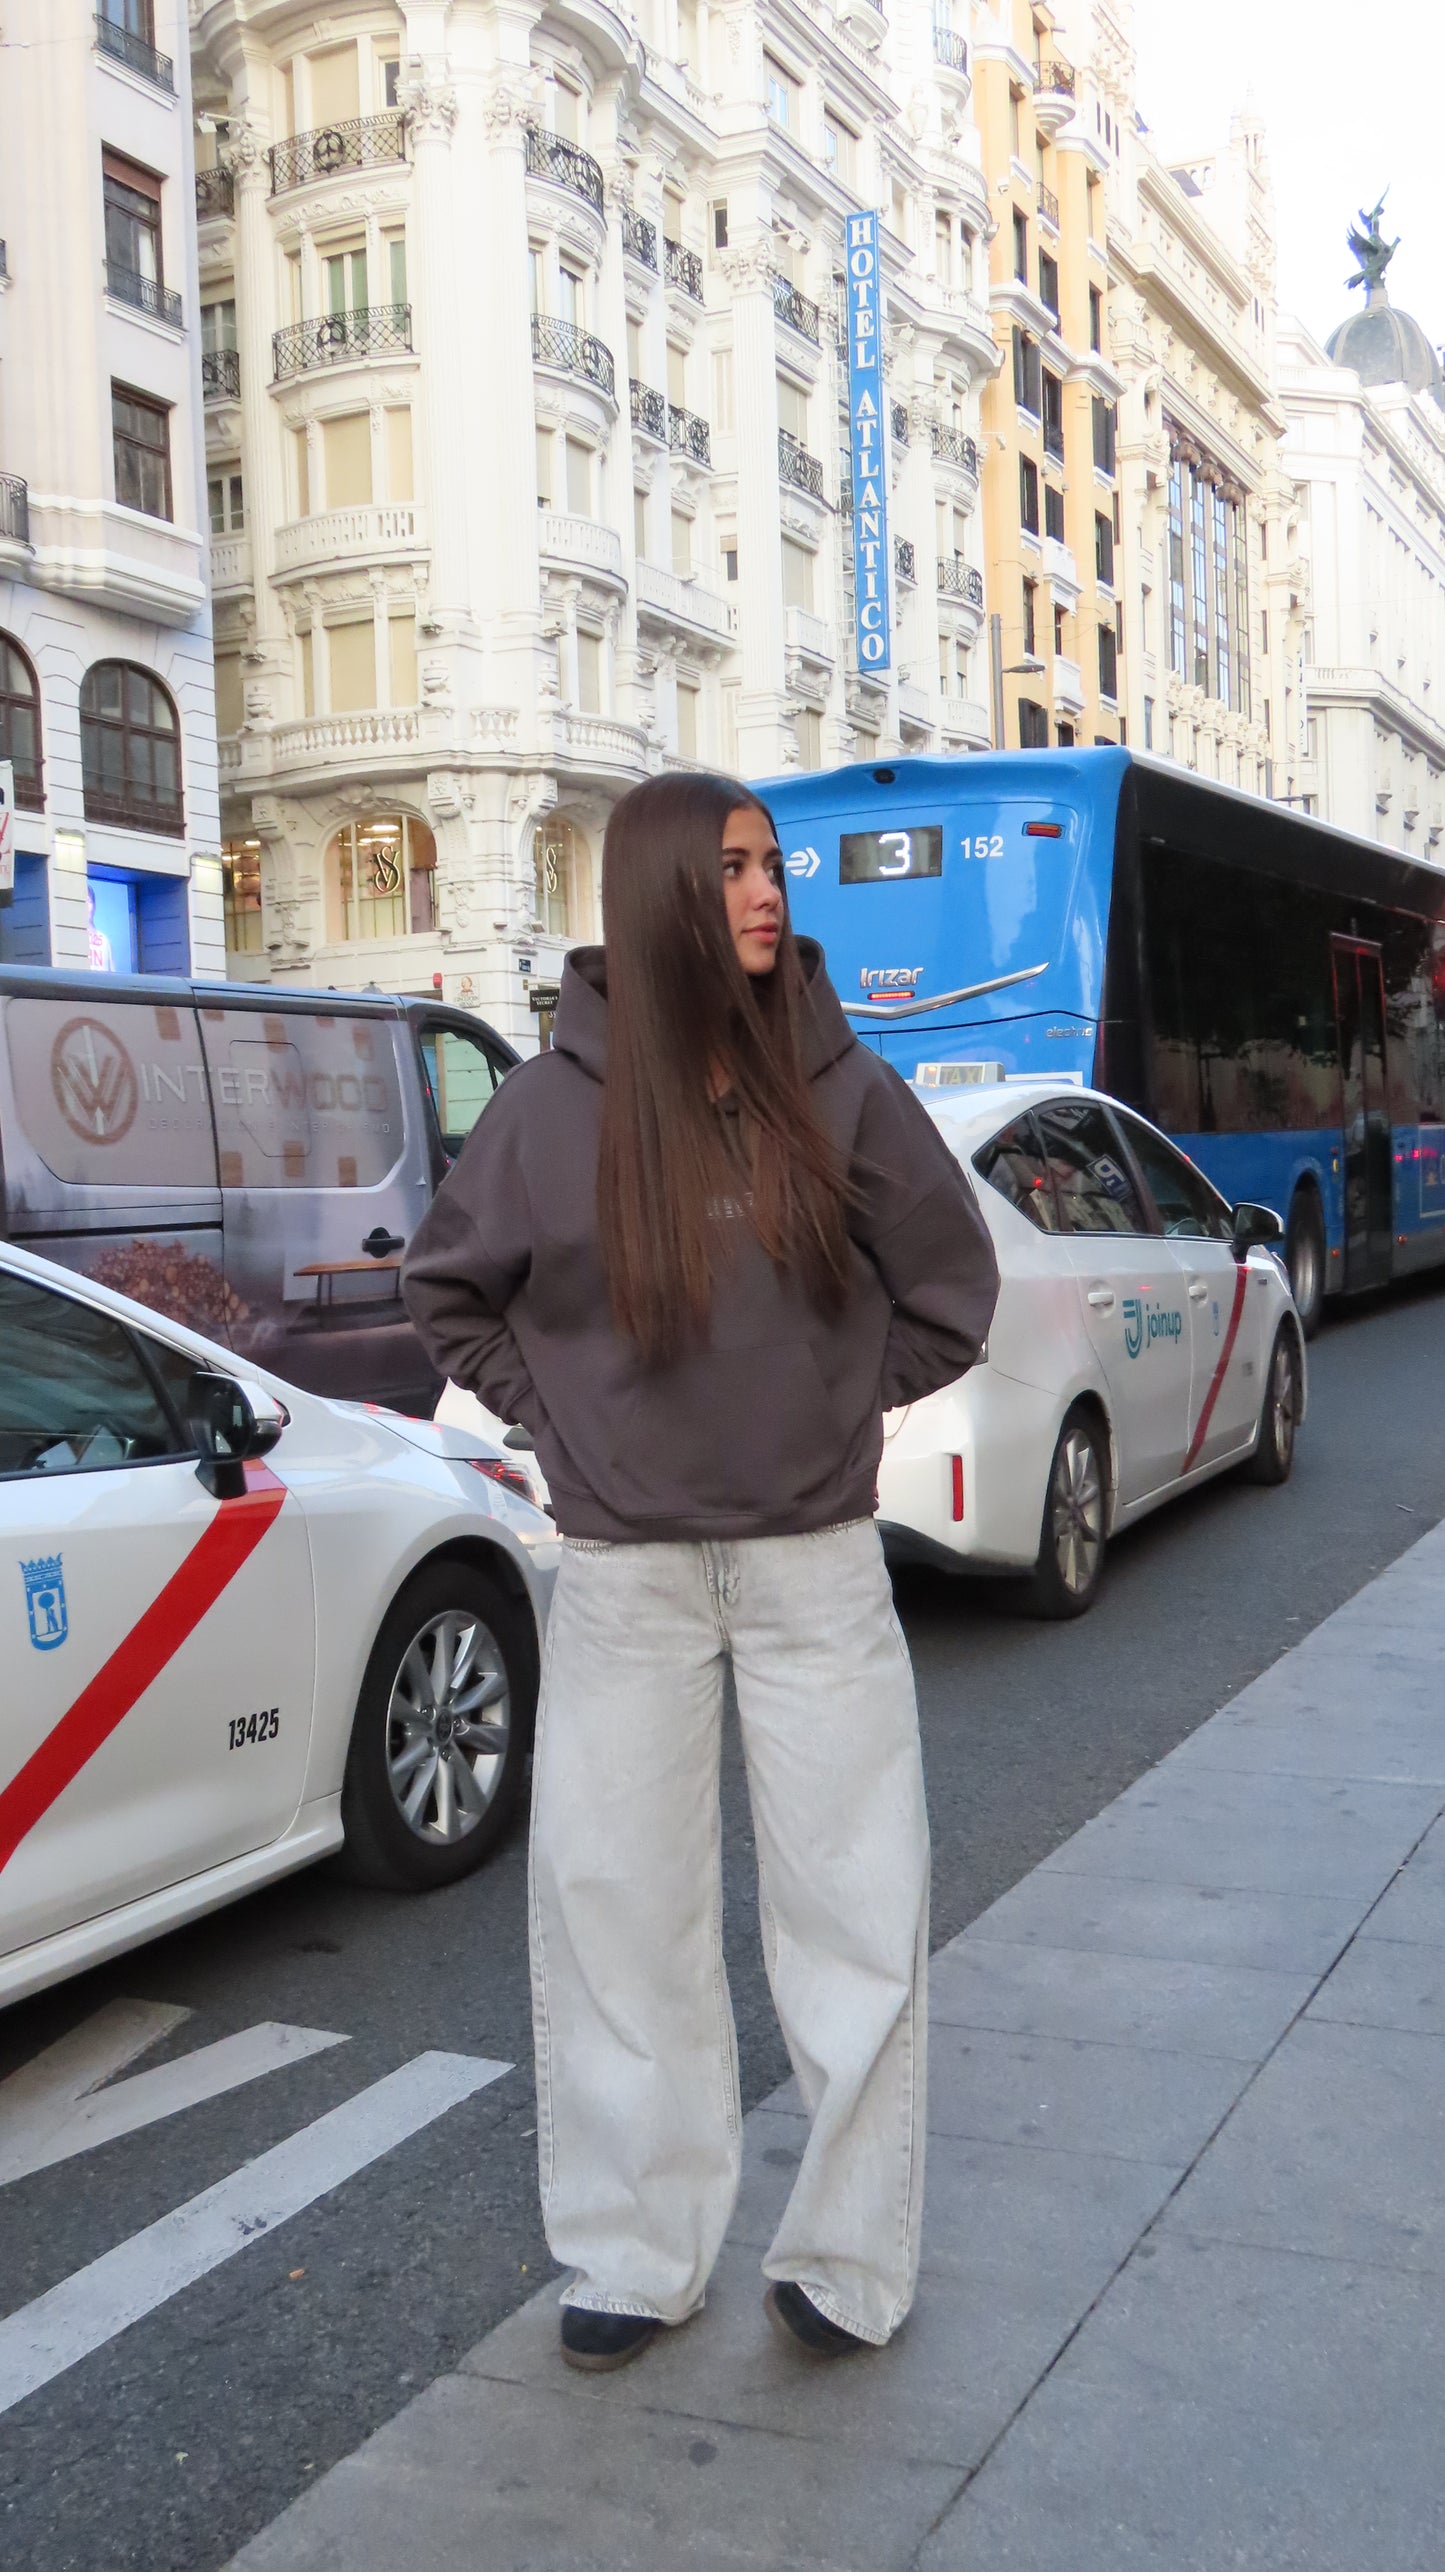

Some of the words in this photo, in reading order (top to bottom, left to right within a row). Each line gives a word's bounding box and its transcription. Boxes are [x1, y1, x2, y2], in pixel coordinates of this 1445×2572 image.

[850, 217, 876, 369] HOTEL
[856, 389, 885, 661] ATLANTICO
[878, 831, 911, 876] 3
[960, 835, 1004, 859] 152
[1046, 1026, 1093, 1038] electric
[1146, 1303, 1182, 1348] joinup
[228, 1707, 279, 1751] 13425
